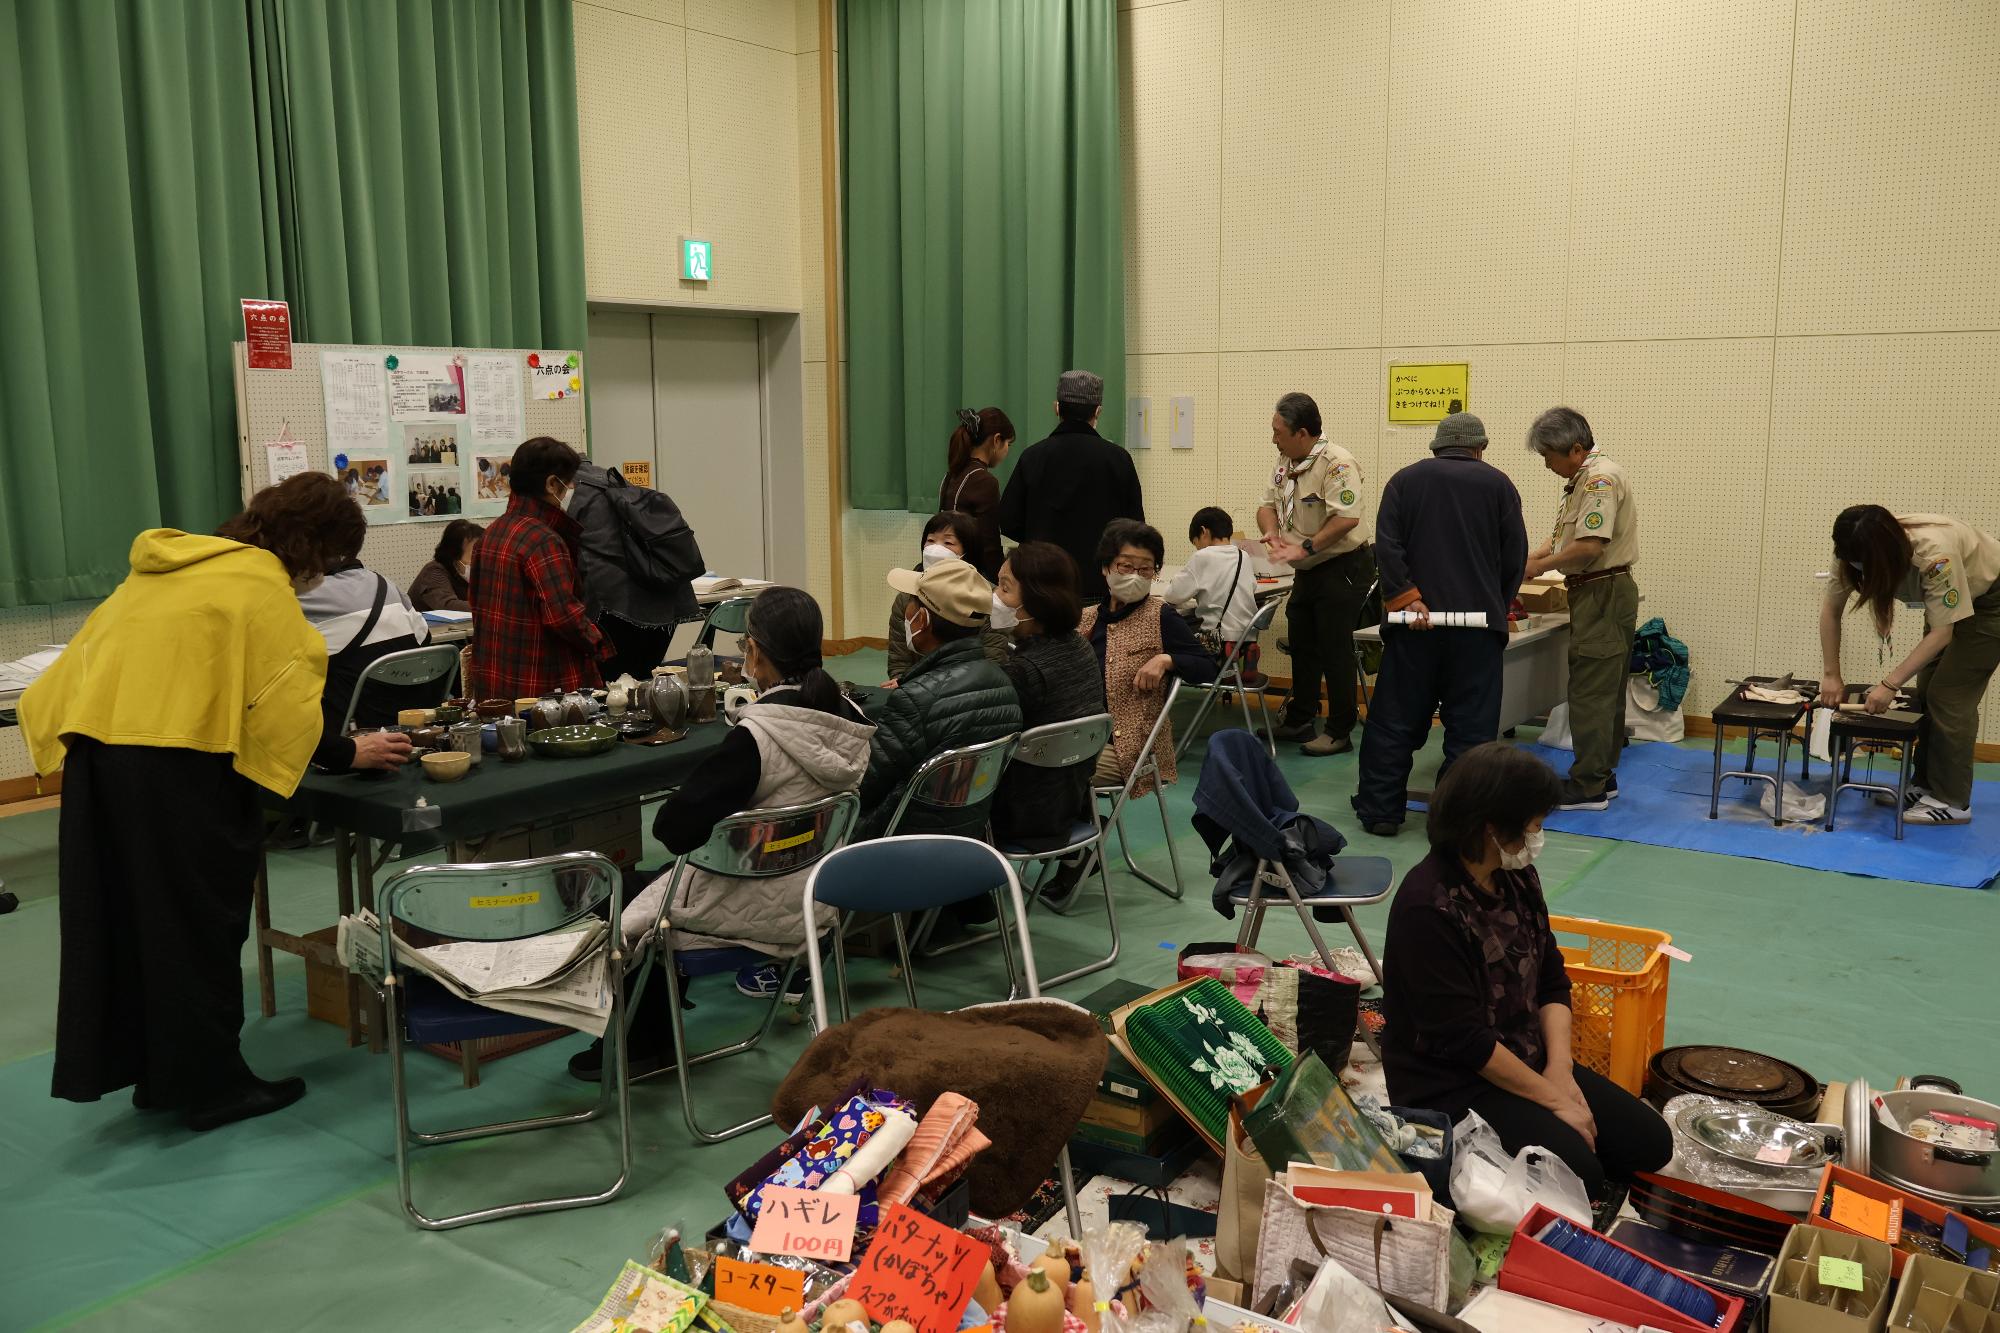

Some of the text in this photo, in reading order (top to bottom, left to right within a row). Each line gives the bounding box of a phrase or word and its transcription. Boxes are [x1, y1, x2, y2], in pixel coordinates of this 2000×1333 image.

[250, 313, 286, 323] 六点の会
[535, 363, 571, 376] 六点の会
[1395, 375, 1418, 383] かべに
[1395, 386, 1459, 396] ぶつからないように
[1596, 498, 1602, 507] 2
[476, 894, 535, 906] セミナーハウス
[766, 1197, 841, 1225] ハギレ
[782, 1231, 844, 1257] 100円
[881, 1216, 971, 1272] バターナッツ
[721, 1269, 797, 1296] コースター
[873, 1246, 965, 1311] (かぼちゃ)
[857, 1284, 896, 1308] スープ
